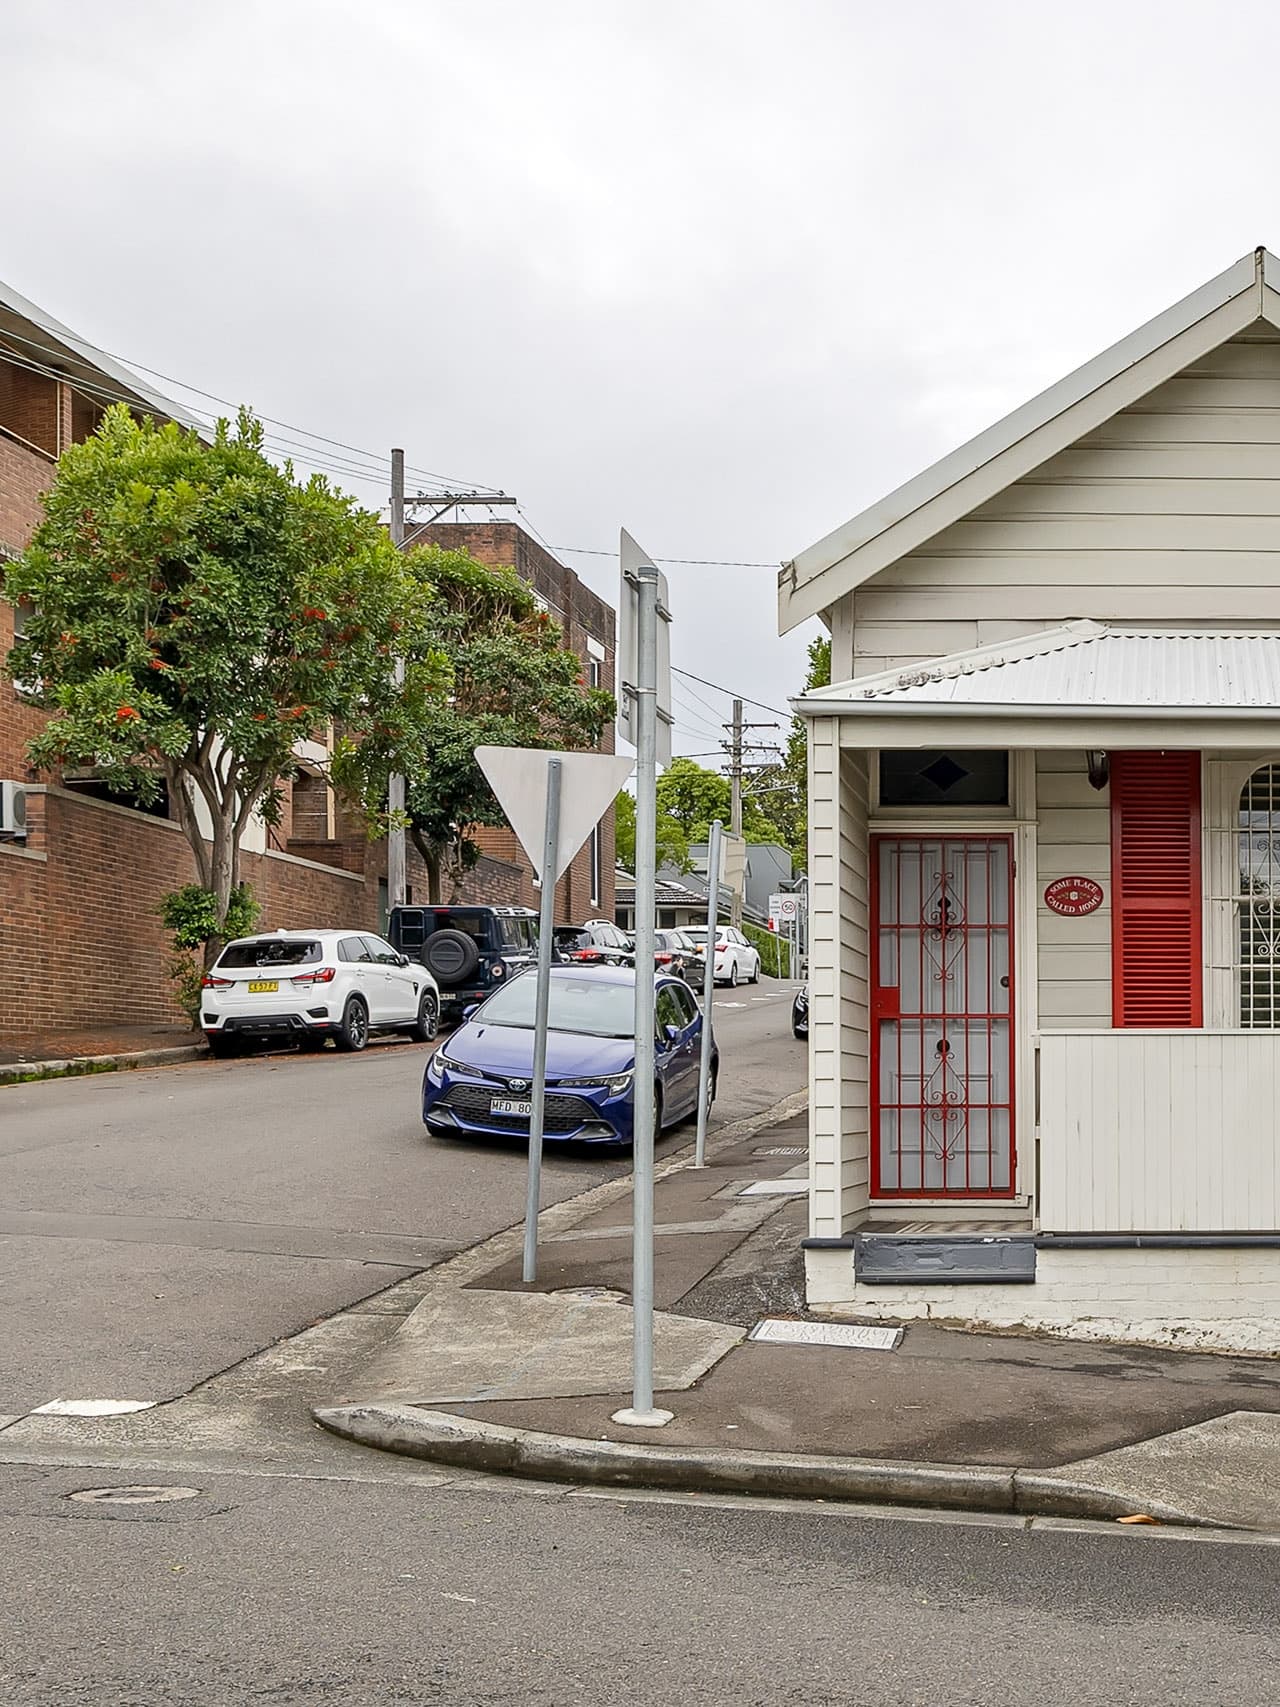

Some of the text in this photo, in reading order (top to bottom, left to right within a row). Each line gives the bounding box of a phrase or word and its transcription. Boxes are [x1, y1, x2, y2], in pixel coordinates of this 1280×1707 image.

[1050, 879, 1099, 894] SOME PLACE
[1047, 894, 1101, 913] CALLED HOME
[518, 1103, 532, 1114] 80
